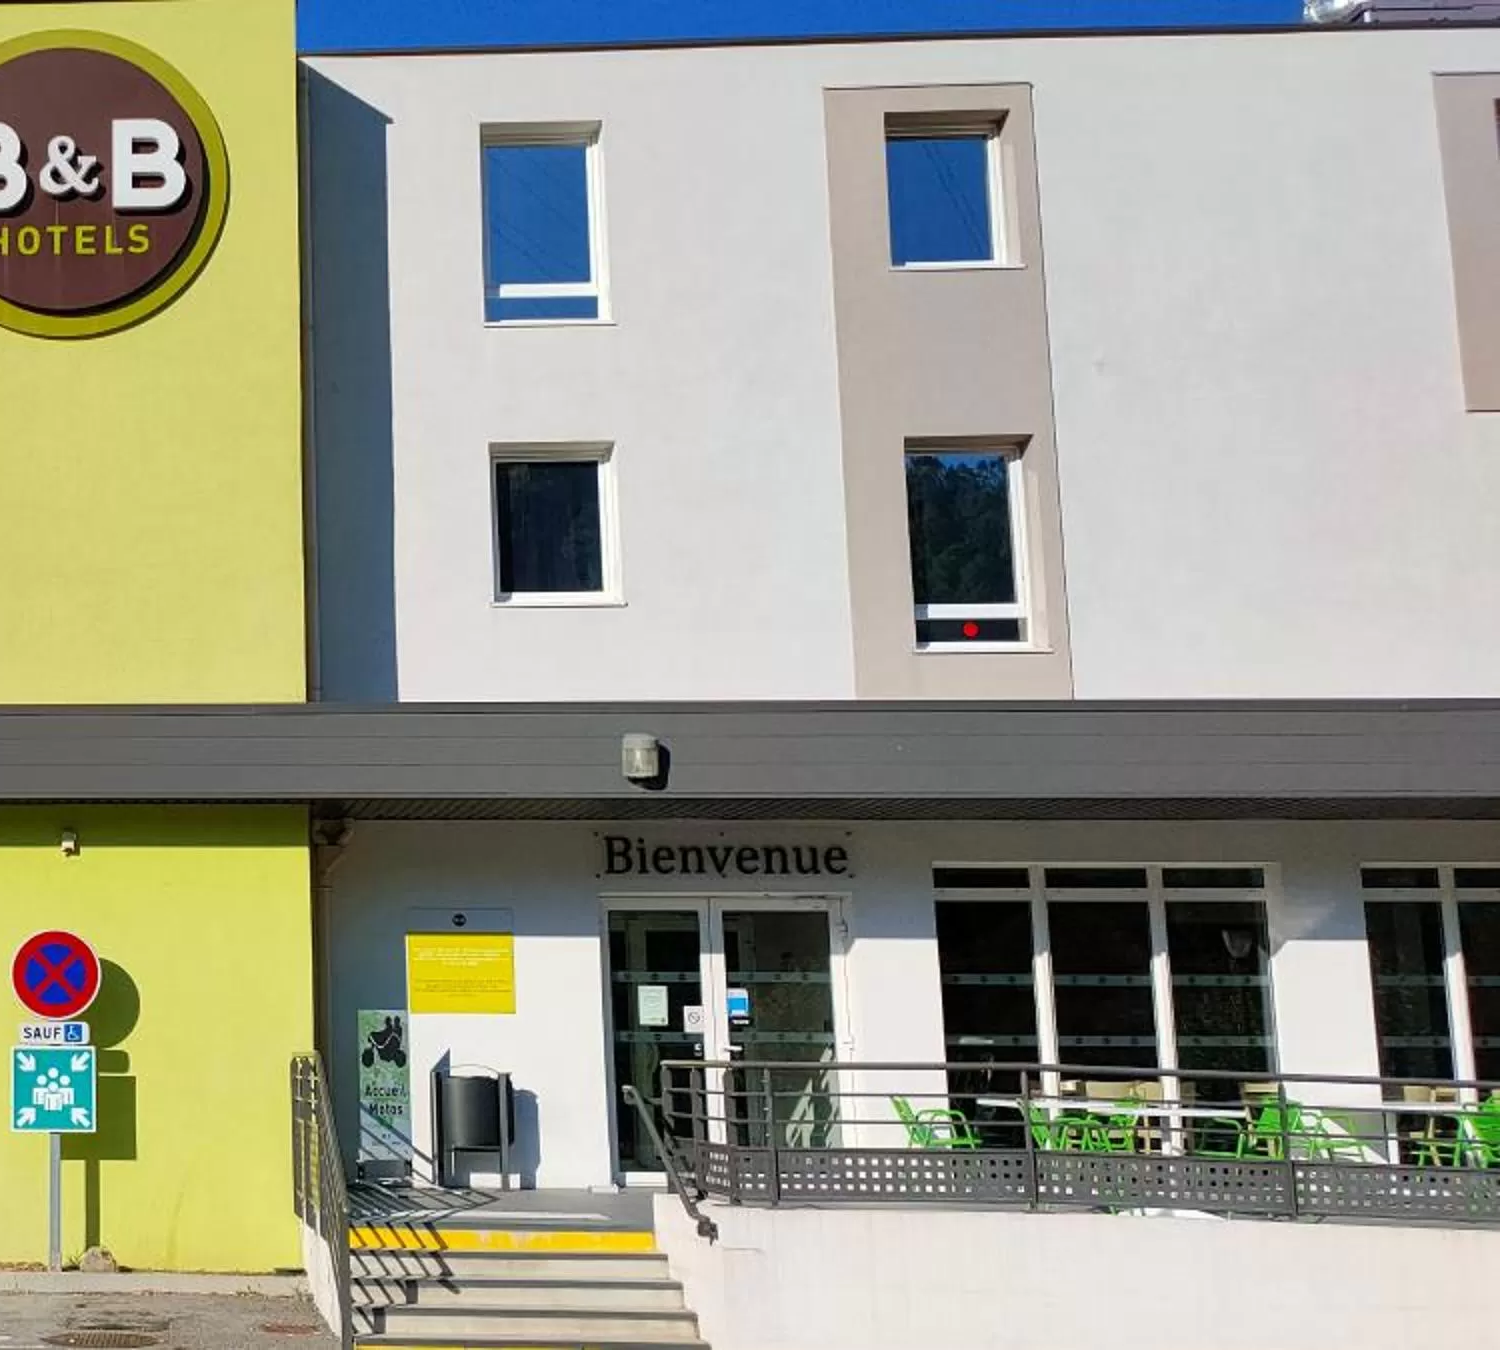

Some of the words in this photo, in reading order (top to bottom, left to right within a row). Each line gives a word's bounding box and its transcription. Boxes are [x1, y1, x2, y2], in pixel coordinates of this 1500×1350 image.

[603, 836, 849, 876] Bienvenue
[23, 1026, 61, 1040] SAUF
[369, 1103, 403, 1116] Motos
